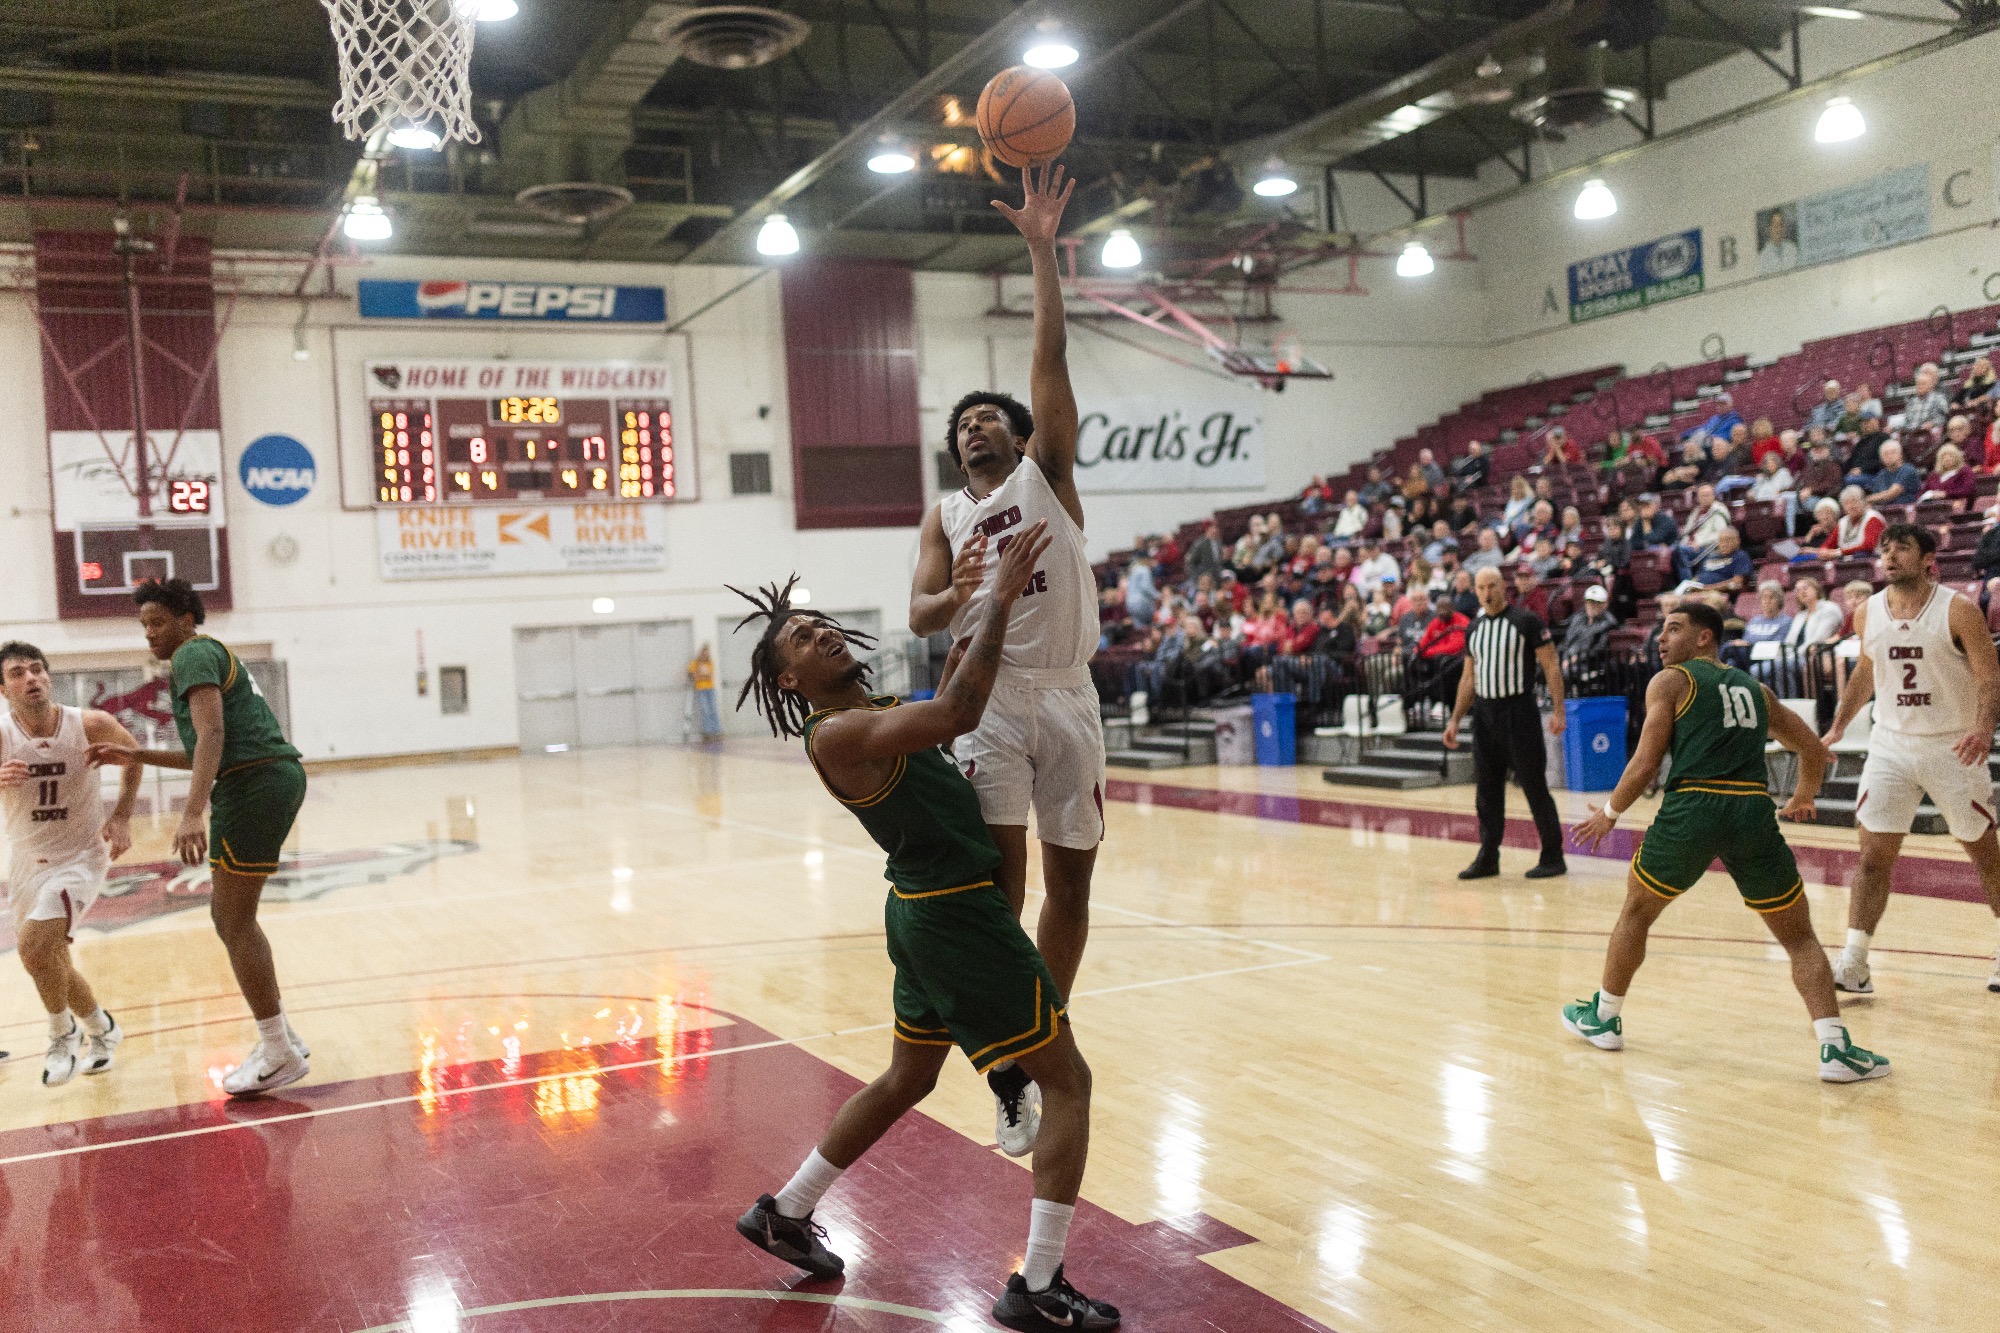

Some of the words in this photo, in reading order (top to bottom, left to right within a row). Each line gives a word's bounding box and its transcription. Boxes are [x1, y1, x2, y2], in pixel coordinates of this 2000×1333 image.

[1942, 169, 1972, 208] C
[1719, 235, 1738, 271] B
[1577, 249, 1632, 285] KPAY
[465, 283, 617, 318] PEPSI
[406, 365, 468, 388] HOME
[479, 366, 502, 388] OF
[515, 366, 552, 388] THE
[561, 366, 667, 389] WILDCATS!
[500, 397, 560, 424] 13:26
[469, 437, 487, 464] 8
[526, 440, 536, 460] 1
[582, 436, 606, 461] 17
[1074, 408, 1190, 469] Carl's
[1194, 411, 1253, 468] Jr.
[246, 466, 314, 490] NCAA
[454, 471, 471, 491] 4
[481, 471, 498, 491] 4
[561, 469, 578, 489] 4
[171, 480, 209, 511] 22
[401, 530, 477, 550] RIVER
[575, 524, 647, 543] RIVER
[1888, 646, 1923, 660] CHICO
[1903, 663, 1917, 690] 2
[1718, 683, 1758, 730] 10
[1897, 693, 1931, 707] STATE
[40, 780, 58, 806] 11
[31, 807, 68, 822] STATE
